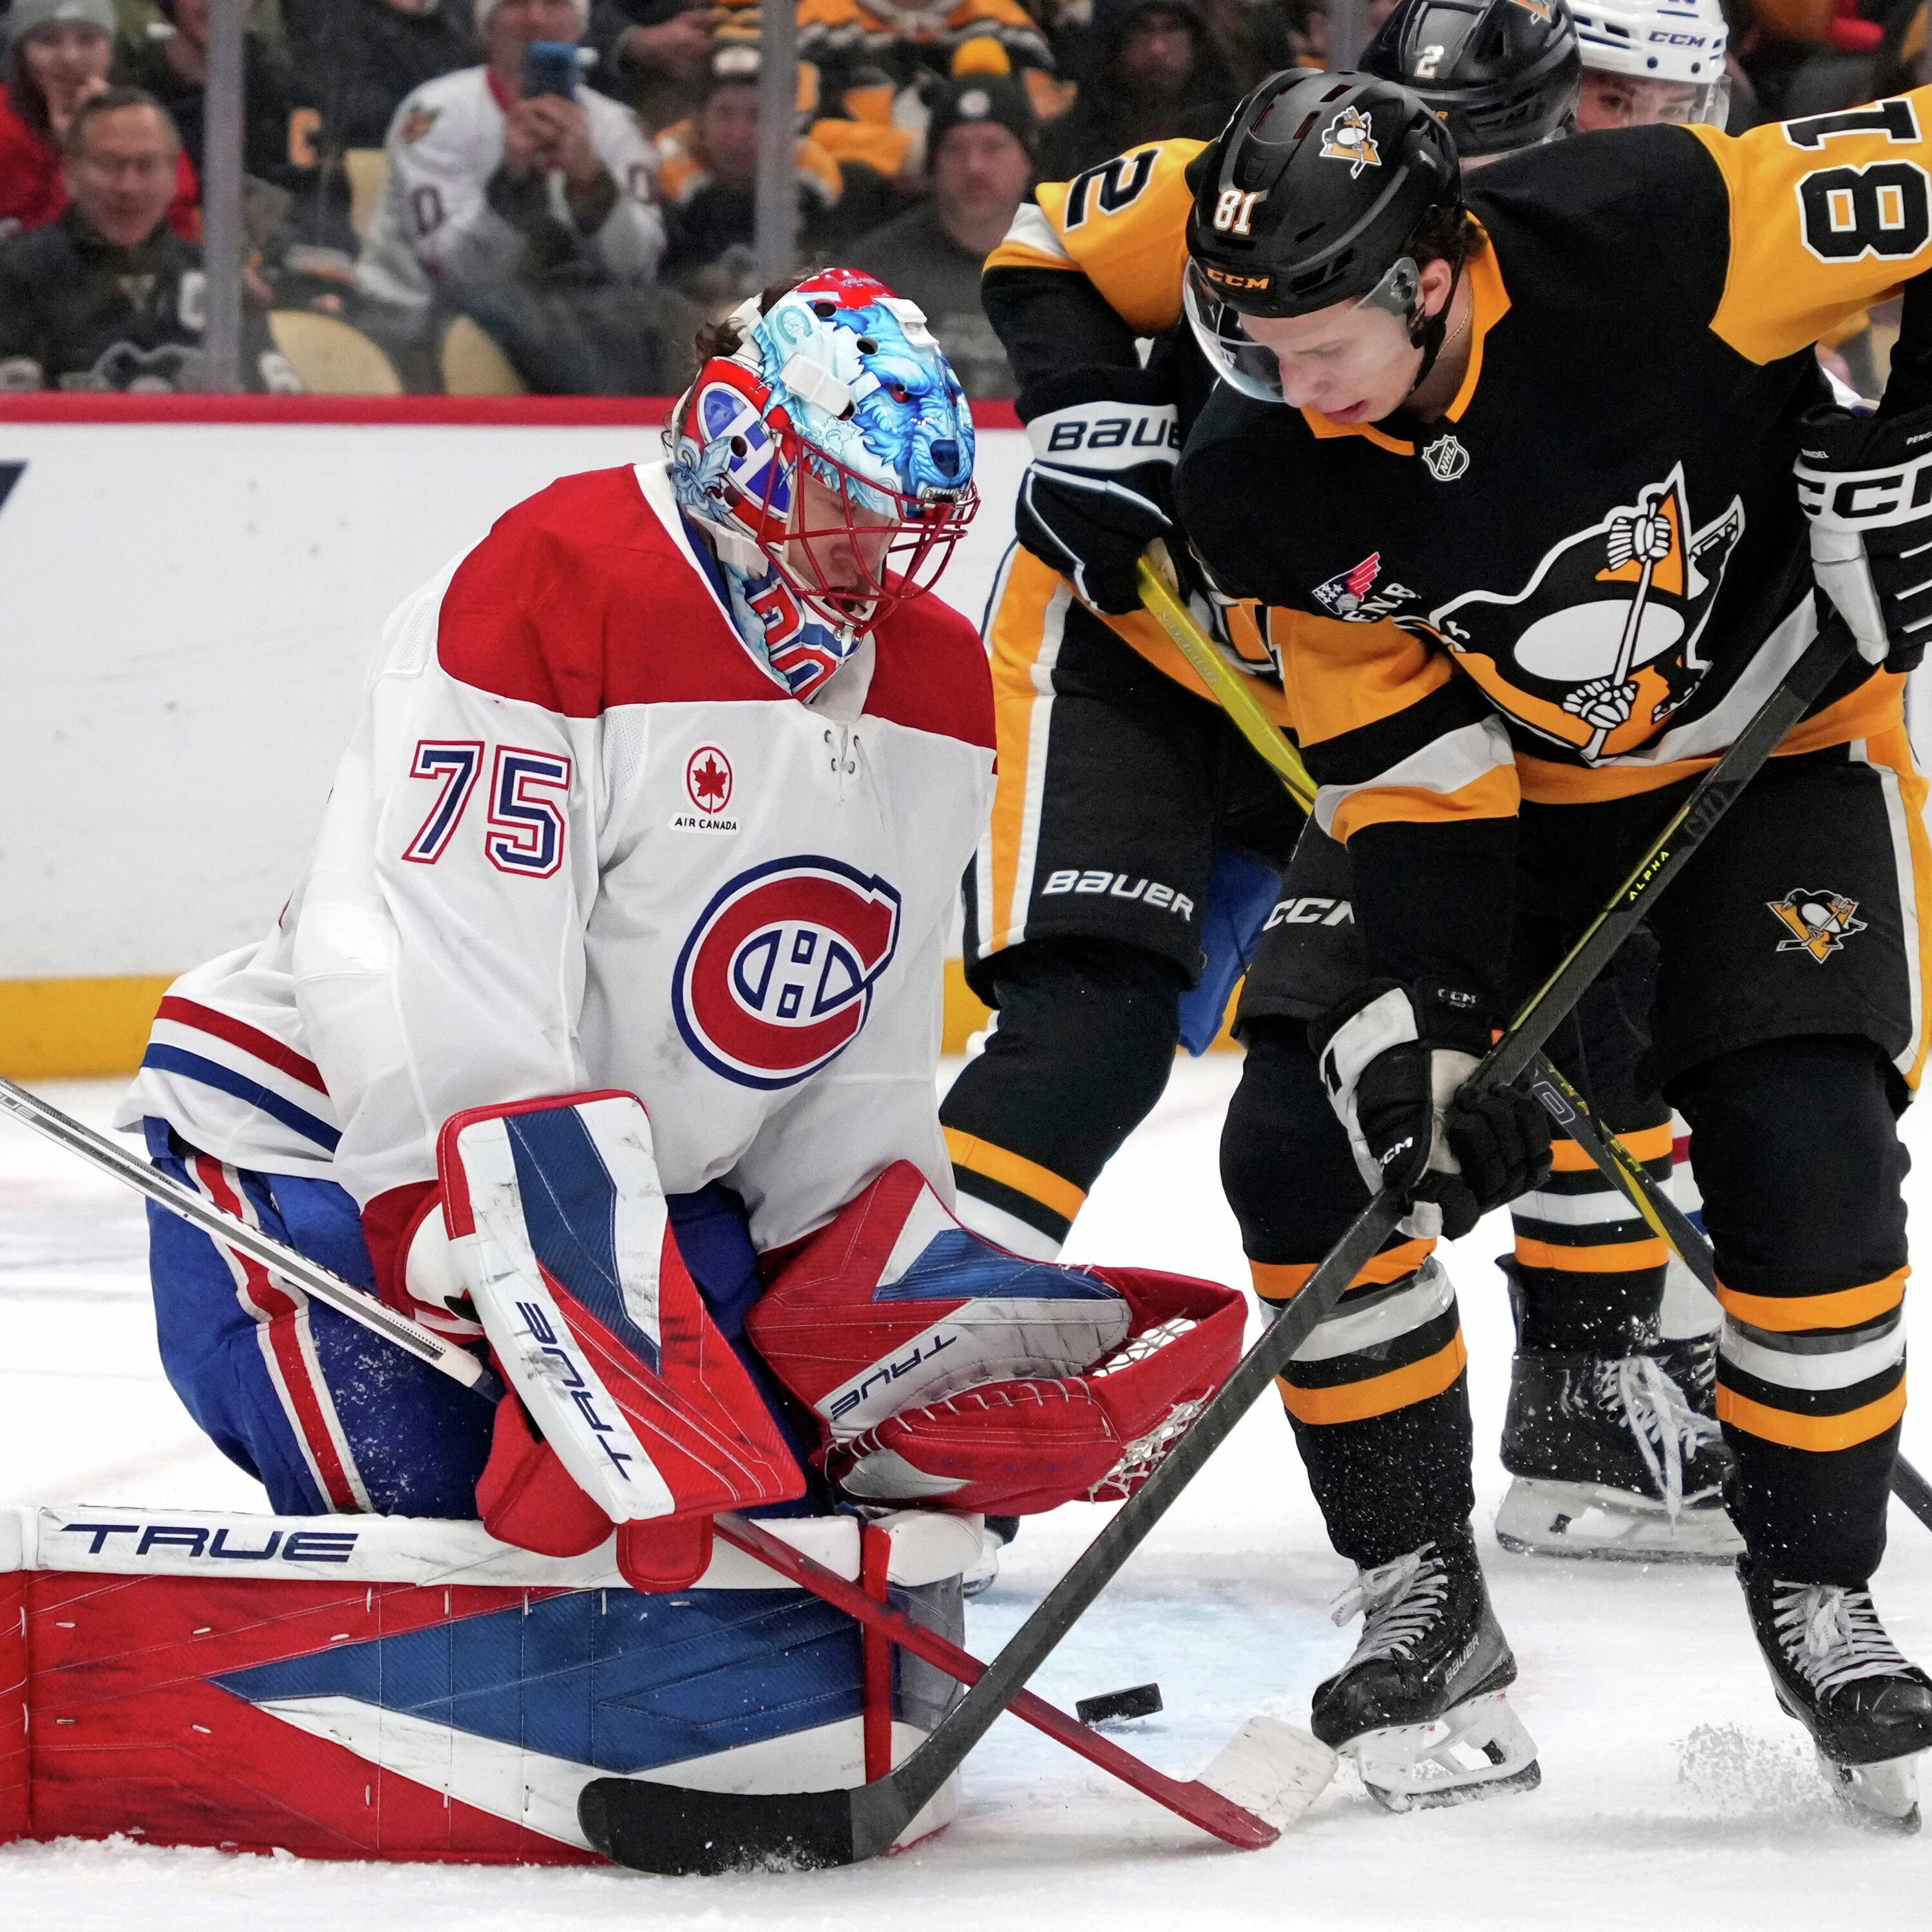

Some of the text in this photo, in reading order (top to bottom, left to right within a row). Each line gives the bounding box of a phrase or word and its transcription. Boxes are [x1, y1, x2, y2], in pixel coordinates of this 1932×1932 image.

[1413, 44, 1444, 79] 2
[1649, 30, 1707, 48] CCM
[1063, 146, 1164, 234] 2
[1781, 96, 1932, 264] 81
[1213, 187, 1260, 235] 81
[1206, 267, 1270, 289] CCM
[401, 740, 571, 879] 75
[674, 817, 737, 831] AIR CANADA
[1041, 870, 1195, 922] BAUER
[1629, 851, 1669, 901] ALPHA
[515, 1302, 632, 1482] TRUE
[829, 1334, 958, 1421] TRUE
[60, 1523, 359, 1563] TRUE
[1444, 1633, 1479, 1685] BAUER
